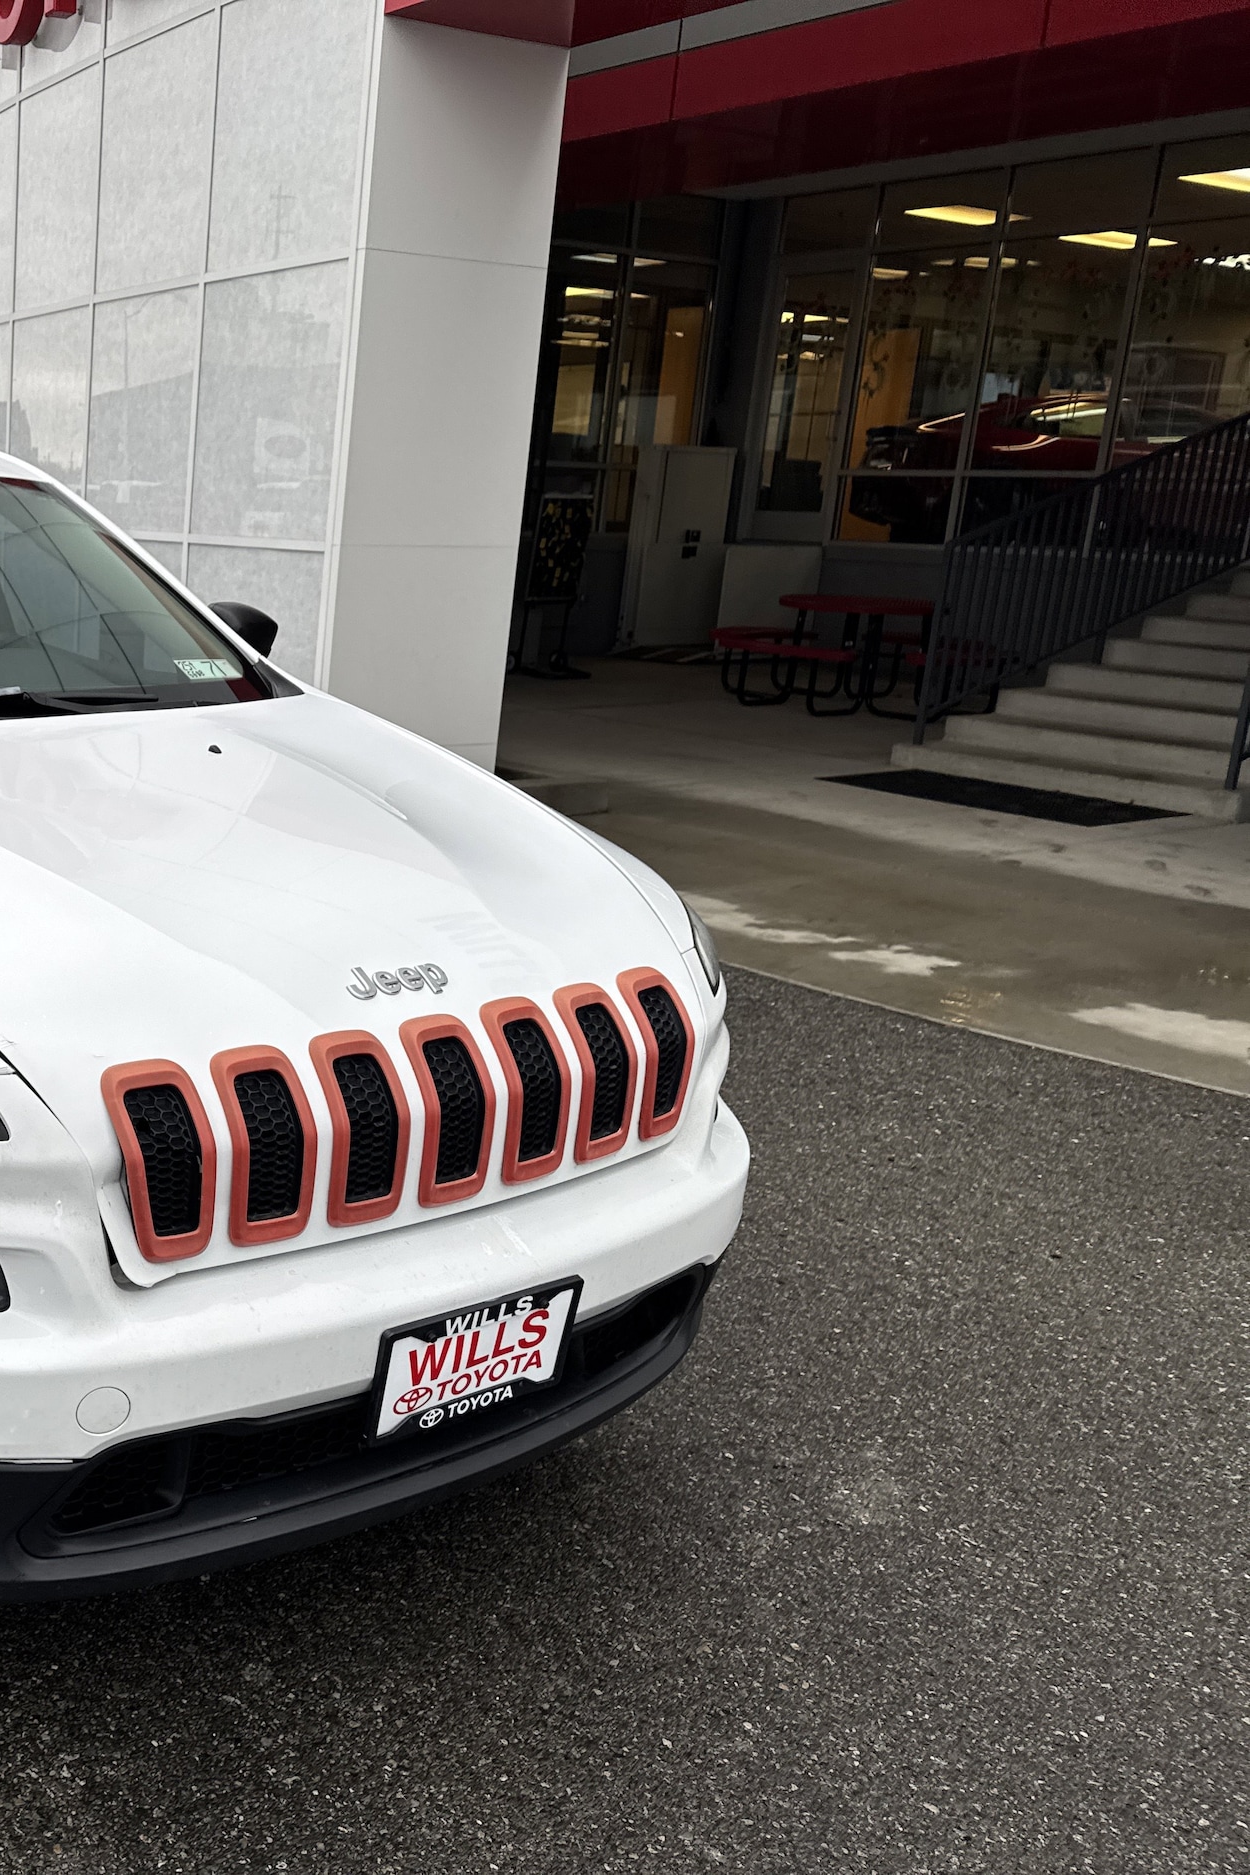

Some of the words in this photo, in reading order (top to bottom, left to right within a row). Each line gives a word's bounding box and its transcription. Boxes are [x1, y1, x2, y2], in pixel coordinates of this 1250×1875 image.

[346, 963, 448, 1000] Jeep
[445, 1295, 534, 1337] WILLS
[408, 1309, 550, 1387] WILLS
[437, 1350, 543, 1401] TOYOTA
[447, 1385, 514, 1419] TOYOTA
